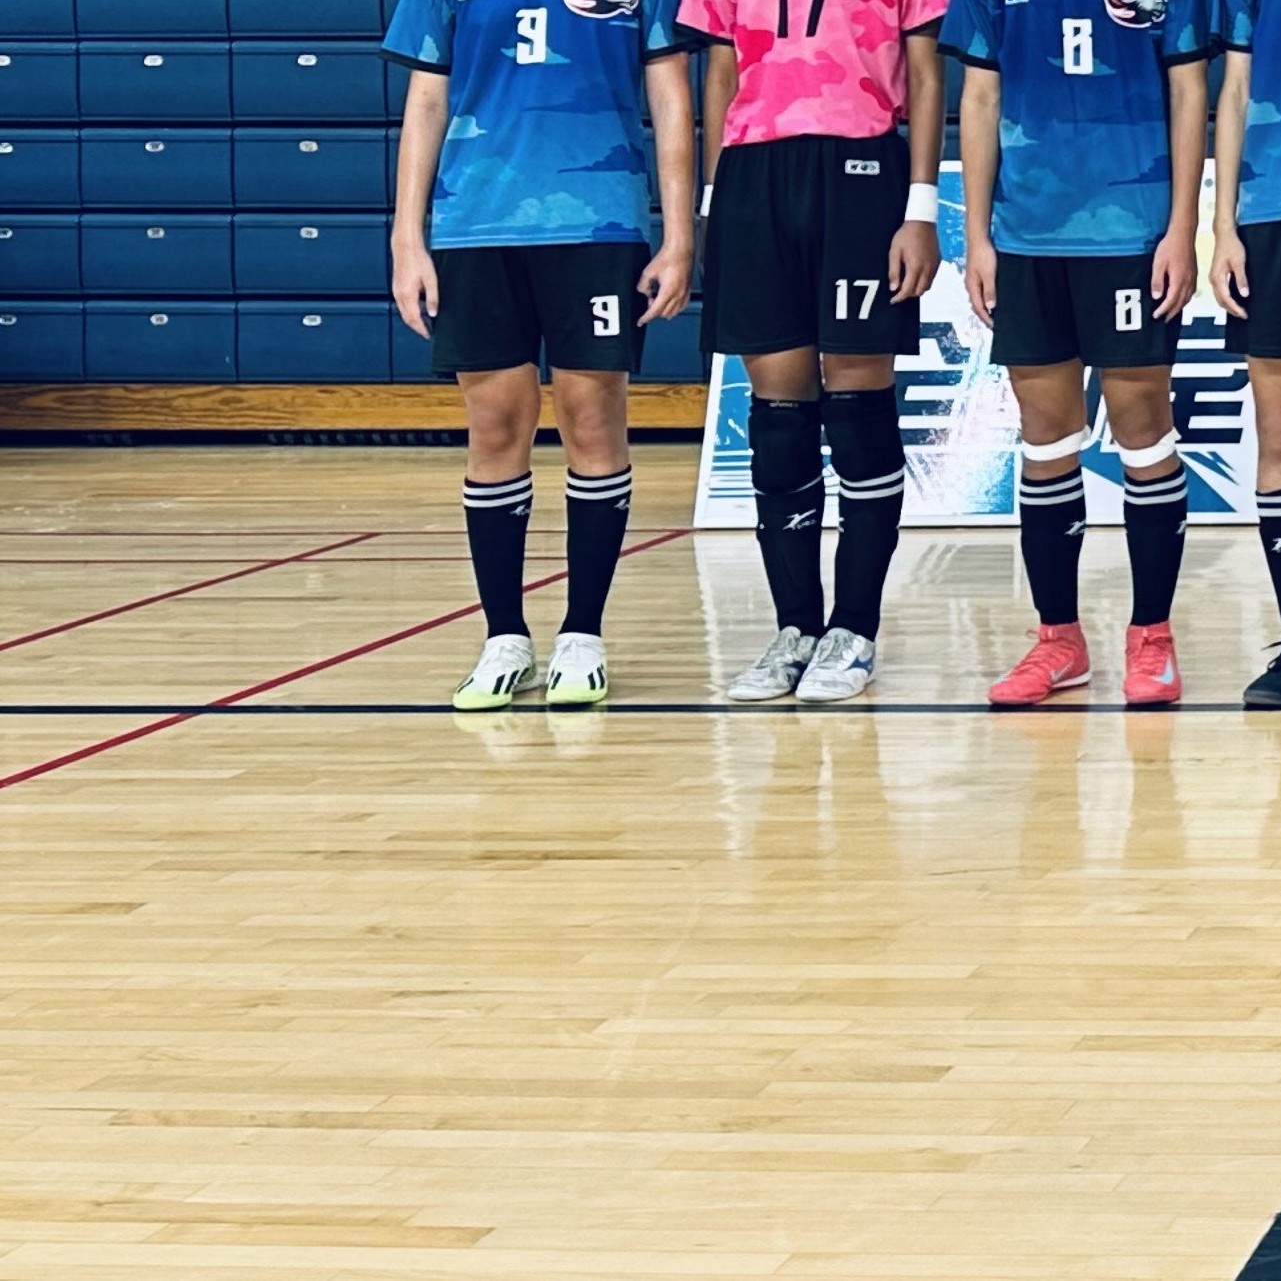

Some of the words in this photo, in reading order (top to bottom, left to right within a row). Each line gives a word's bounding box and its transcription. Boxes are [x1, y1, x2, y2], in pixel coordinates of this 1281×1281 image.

[515, 7, 547, 65] 9
[1062, 18, 1093, 75] 8
[590, 295, 620, 336] 9
[835, 279, 880, 320] 17
[1115, 289, 1142, 331] 8
